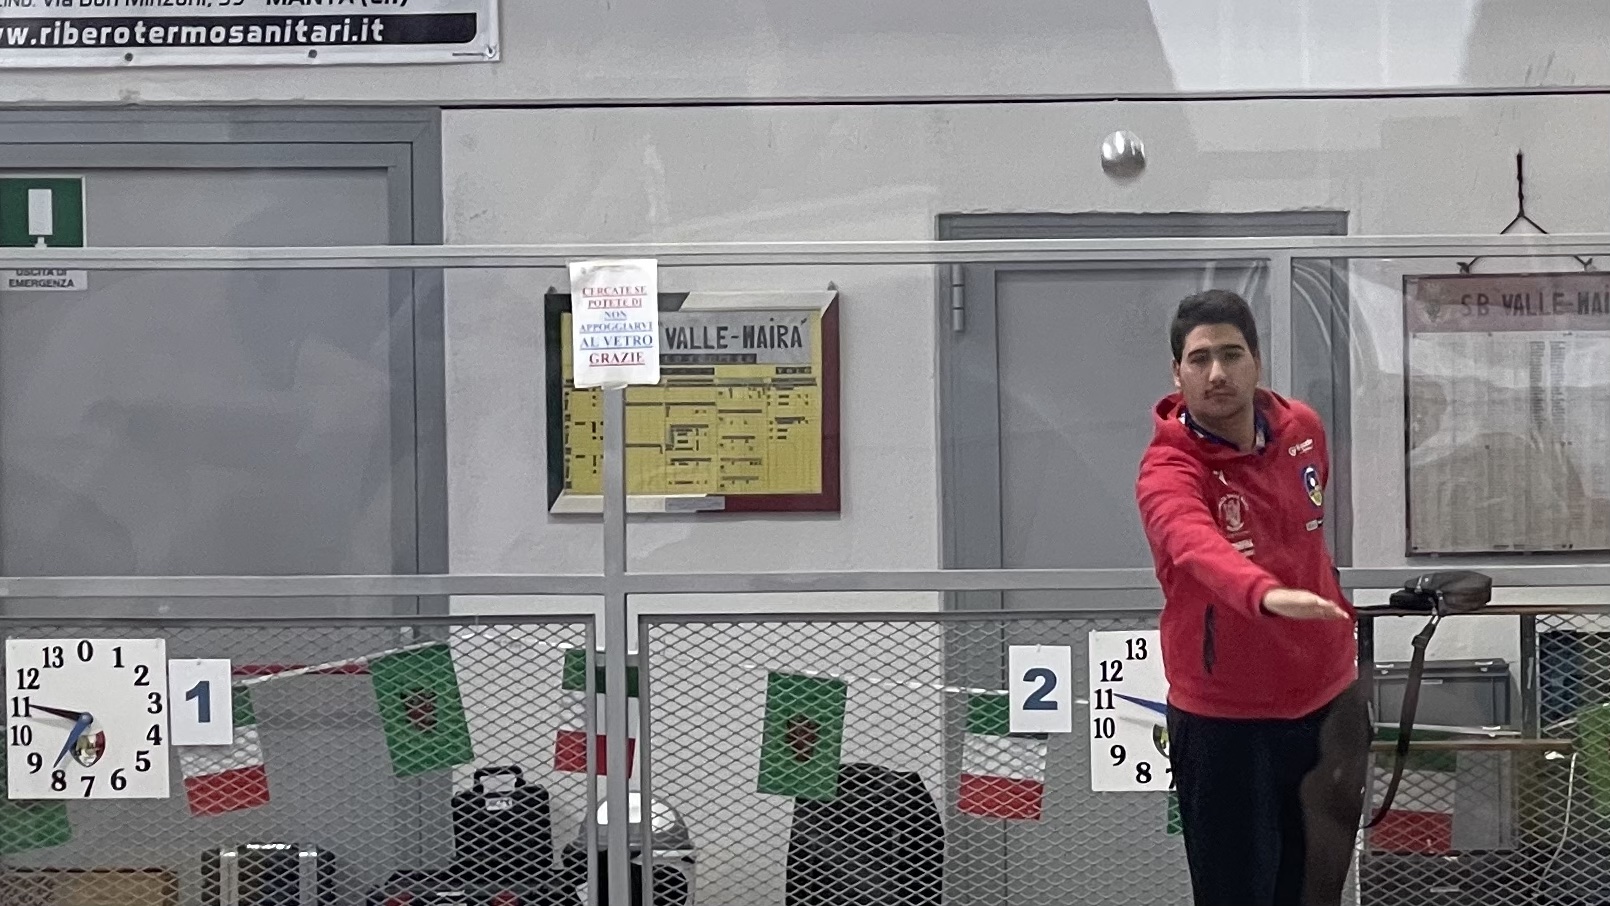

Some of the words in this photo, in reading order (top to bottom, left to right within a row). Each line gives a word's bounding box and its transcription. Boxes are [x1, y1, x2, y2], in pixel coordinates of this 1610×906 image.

[0, 18, 384, 45] w.riberotermosanitari.it
[9, 279, 74, 288] EMERGENZA
[604, 311, 627, 319] NON
[1460, 292, 1490, 317] SB
[580, 336, 599, 348] AL
[604, 334, 653, 347] VETRO
[589, 352, 645, 364] GRAZIE
[42, 646, 64, 668] 13
[77, 640, 94, 662] 0
[112, 646, 125, 668] 1
[1125, 637, 1148, 660] 13
[17, 667, 40, 690] 12
[134, 665, 150, 686] 2
[1100, 660, 1124, 682] 12
[1022, 667, 1059, 711] 2
[1094, 688, 1115, 710] 11
[11, 696, 32, 717] 11
[147, 692, 163, 714] 3
[185, 680, 211, 723] 1
[11, 725, 33, 746] 10
[146, 724, 162, 746] 4
[1094, 717, 1116, 739] 10
[27, 752, 43, 774] 9
[135, 750, 151, 772] 5
[1110, 744, 1126, 767] 9
[51, 769, 67, 791] 8
[110, 768, 127, 791] 6
[1135, 761, 1152, 784] 8
[80, 775, 96, 798] 7
